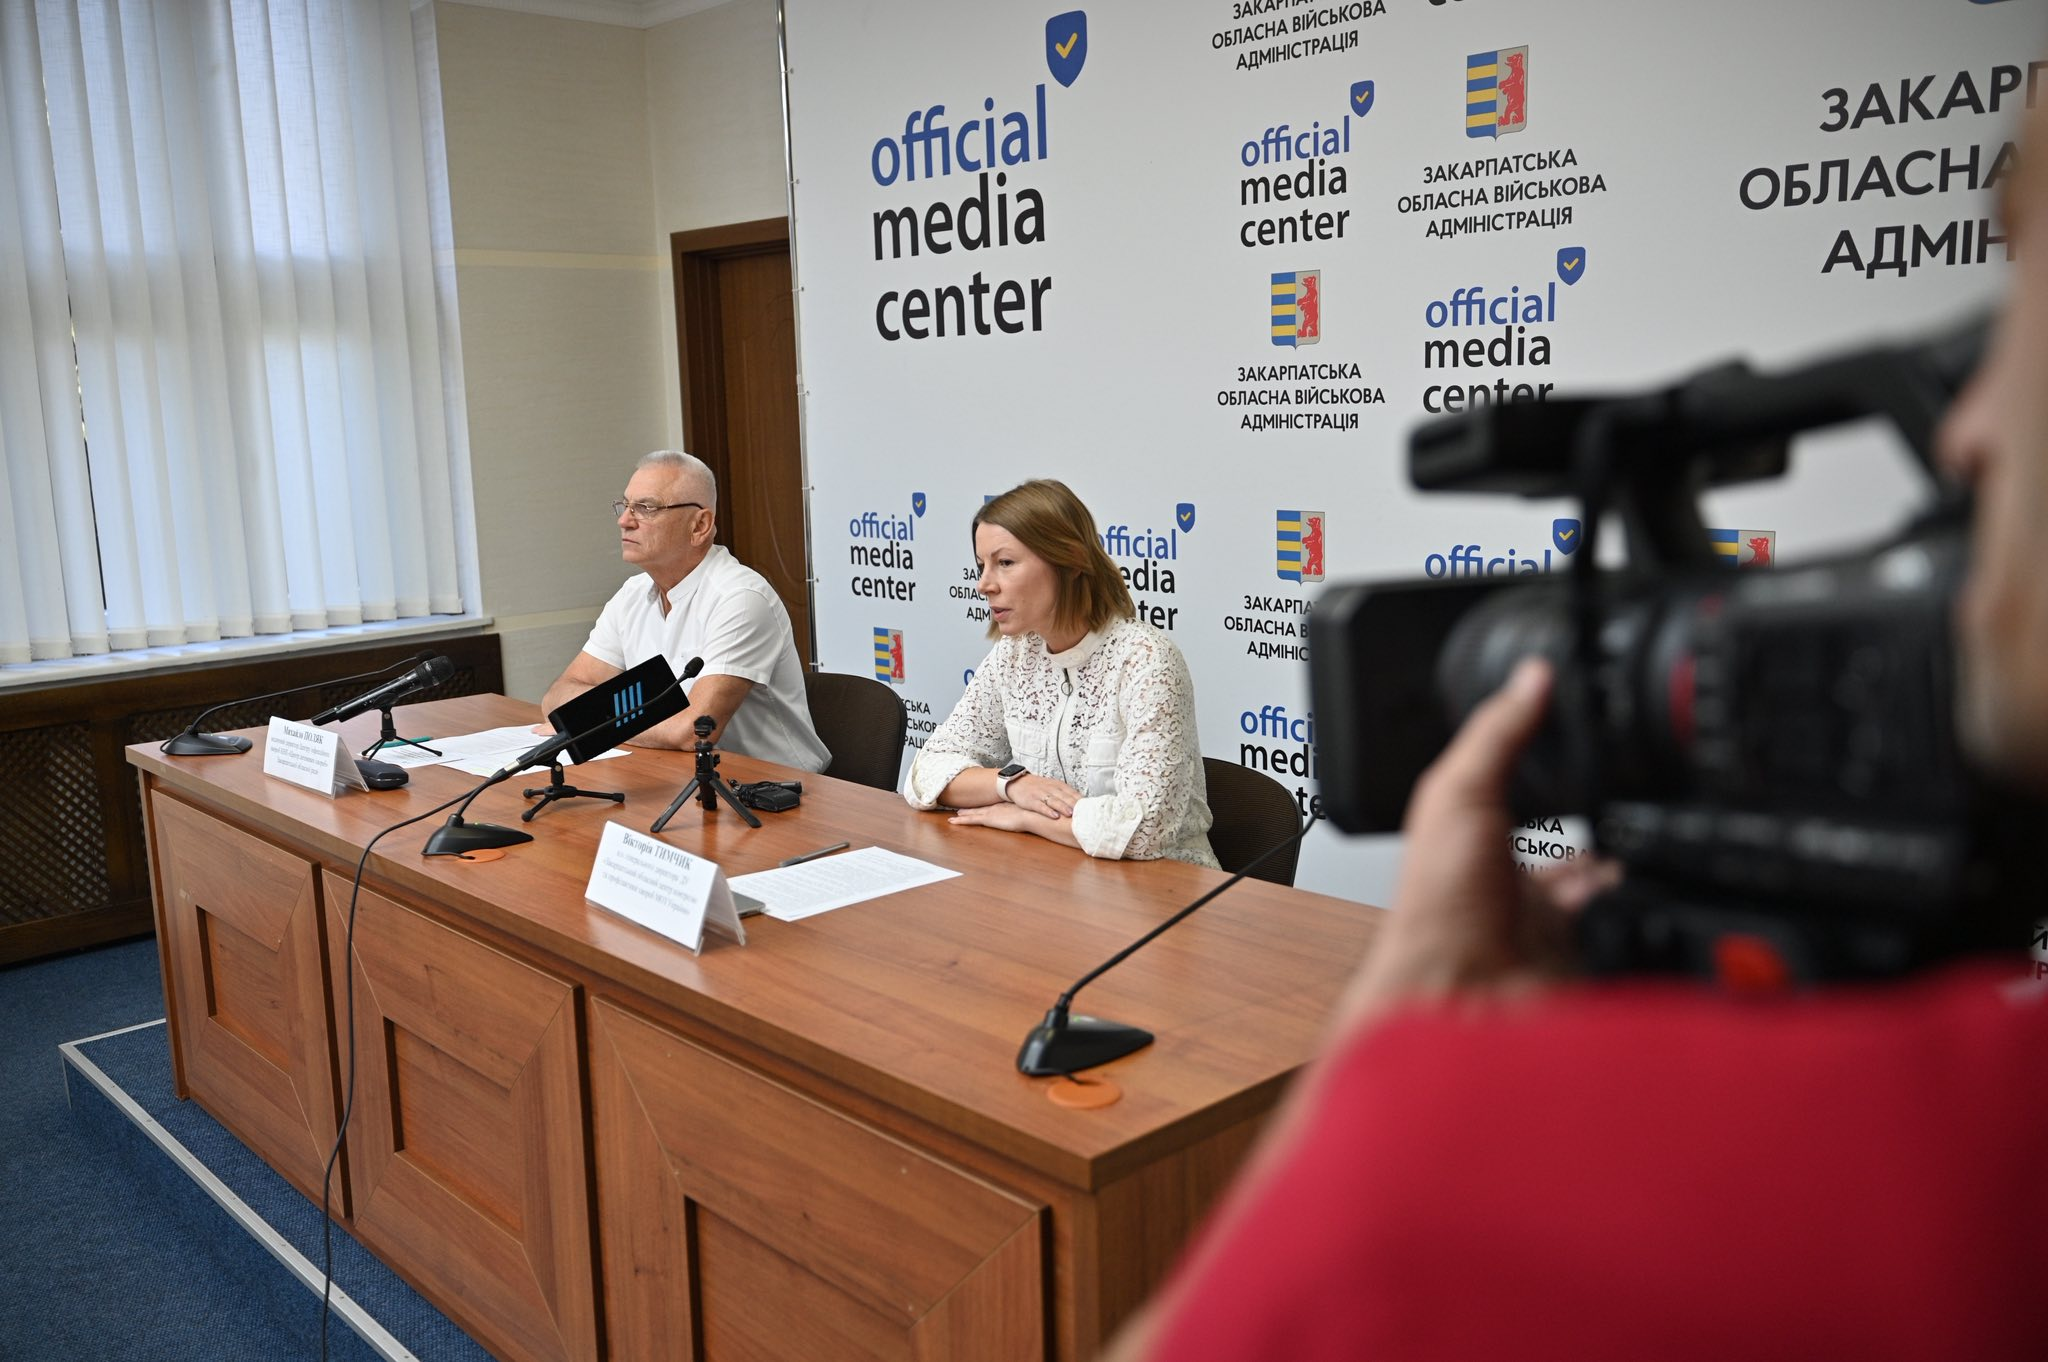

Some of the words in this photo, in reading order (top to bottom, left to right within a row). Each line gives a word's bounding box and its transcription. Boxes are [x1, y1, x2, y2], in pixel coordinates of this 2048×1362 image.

[1212, 19, 1288, 49] ОБЛАСНА
[1292, 0, 1387, 33] ВІЙСЬКОВА
[1236, 30, 1359, 71] АДМІНІСТРАЦІЯ
[871, 83, 1048, 187] official
[1240, 115, 1351, 168] official
[1240, 159, 1348, 206] media
[1422, 148, 1578, 185] ЗАКАРПАТСЬКА
[1397, 186, 1490, 214] ОБЛАСНА
[1493, 173, 1607, 204] ВІЙСЬКОВА
[872, 171, 1046, 261] media
[1239, 207, 1350, 248] center
[1425, 206, 1574, 240] АДМІНІСТРАЦІЯ
[875, 271, 1052, 342] center
[1425, 282, 1556, 328] official
[1424, 325, 1552, 369] media
[1237, 362, 1362, 383] ЗАКАРПАТСЬКА
[1217, 388, 1292, 408] ОБЛАСНА
[1295, 385, 1386, 407] ВІЙСЬКОВА
[1240, 412, 1359, 432] АДМІНІСТРАЦІЯ
[850, 512, 914, 541] official
[850, 540, 914, 570] media
[851, 575, 916, 602] center
[1118, 559, 1175, 594] edia
[1138, 600, 1178, 630] ter
[1244, 595, 1316, 615] ЗАКАРПА
[1224, 616, 1296, 637] ОБЛАСНА
[1247, 641, 1309, 662] АДМІНІС
[1240, 705, 1314, 744] offici
[1240, 743, 1319, 780] medi
